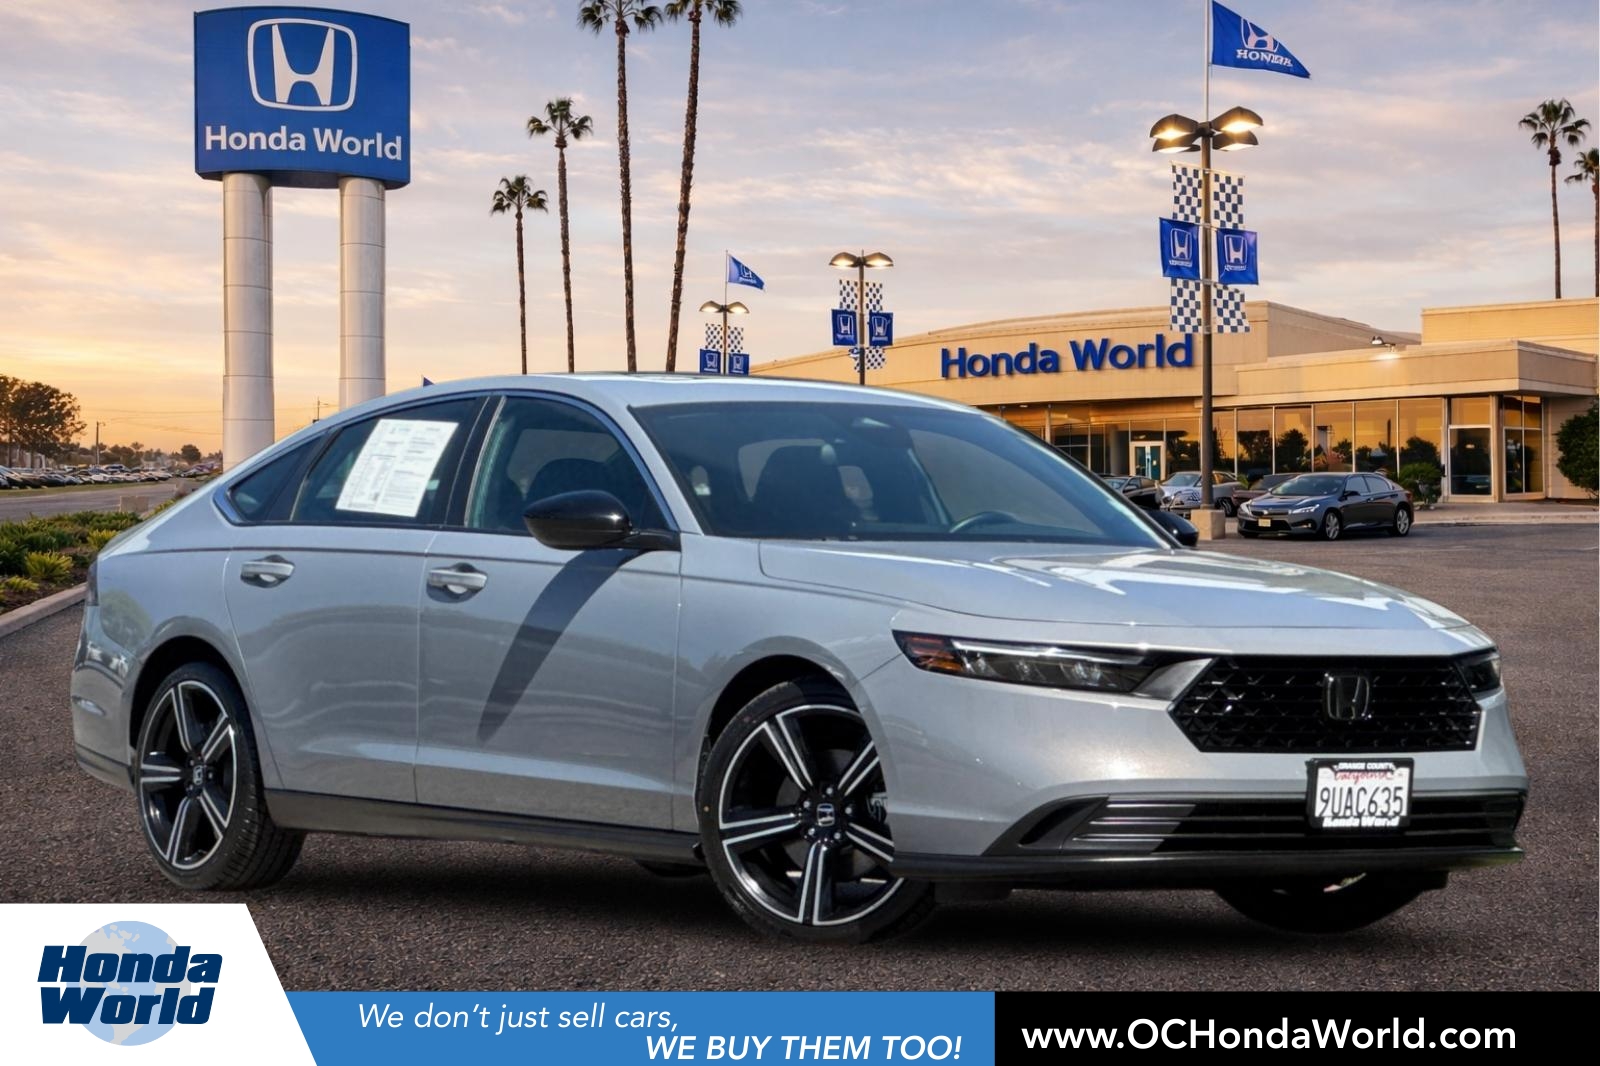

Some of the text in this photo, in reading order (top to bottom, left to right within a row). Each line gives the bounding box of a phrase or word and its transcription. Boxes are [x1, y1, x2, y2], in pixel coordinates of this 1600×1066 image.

[205, 125, 402, 161] Honda World
[941, 333, 1194, 378] Honda World
[1320, 786, 1404, 817] 9UAC635
